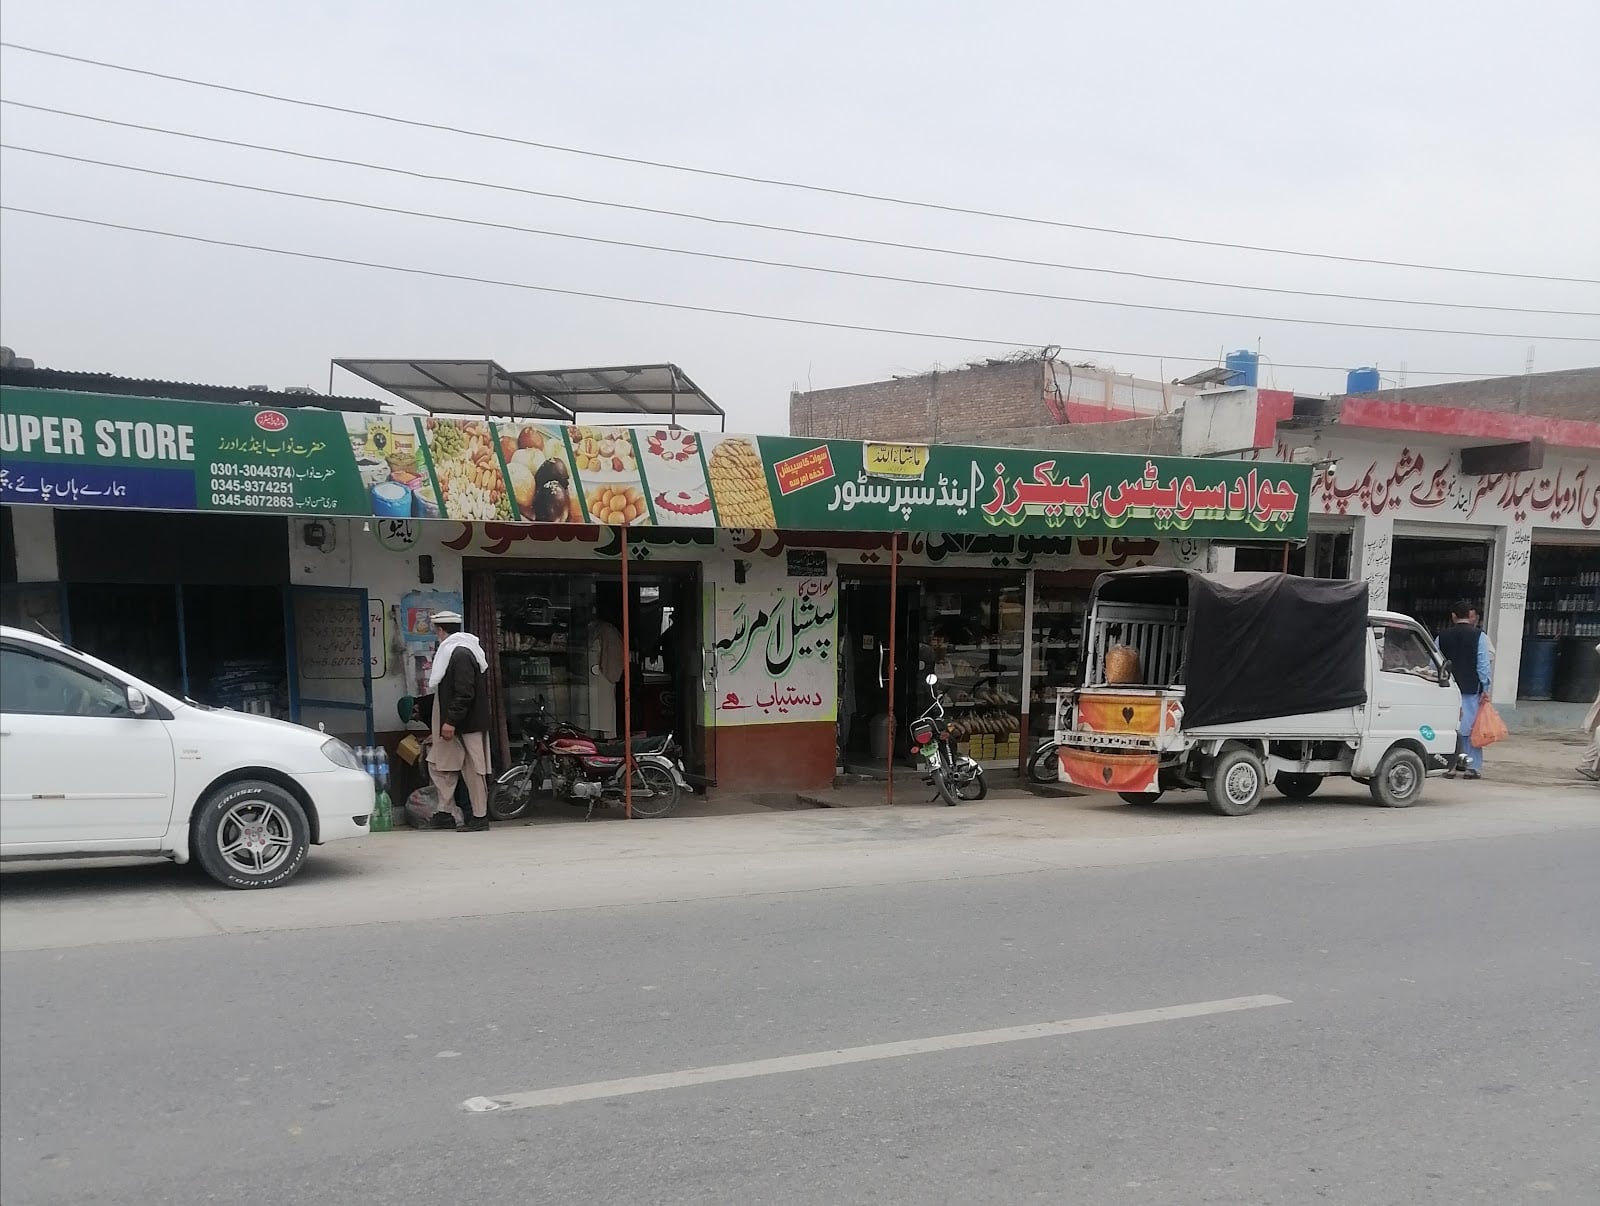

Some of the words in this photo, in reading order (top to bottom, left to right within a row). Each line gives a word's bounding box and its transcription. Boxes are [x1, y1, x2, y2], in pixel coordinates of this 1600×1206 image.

[95, 420, 195, 461] STORE
[218, 437, 247, 452] برادرز
[248, 436, 266, 454] اینڈ
[266, 438, 293, 457] نواب
[293, 441, 326, 458] حضرت
[55, 478, 78, 500] ہاں
[80, 480, 126, 496] ہمارے
[211, 479, 293, 494] 0345-9374251
[827, 470, 890, 511] سٹور
[936, 460, 985, 516] اینڈ
[982, 460, 1090, 517] بیکرز
[1334, 461, 1376, 515] پمپ
[1370, 447, 1424, 515] مشین
[211, 493, 294, 508] 0345-6072863
[889, 481, 935, 522] سپر
[1228, 467, 1298, 522] جواد
[798, 578, 809, 597] کا
[807, 578, 833, 597] سوات
[766, 597, 836, 675] سپیشل
[756, 681, 822, 714] دستیاب
[217, 788, 262, 809] CRUISER
